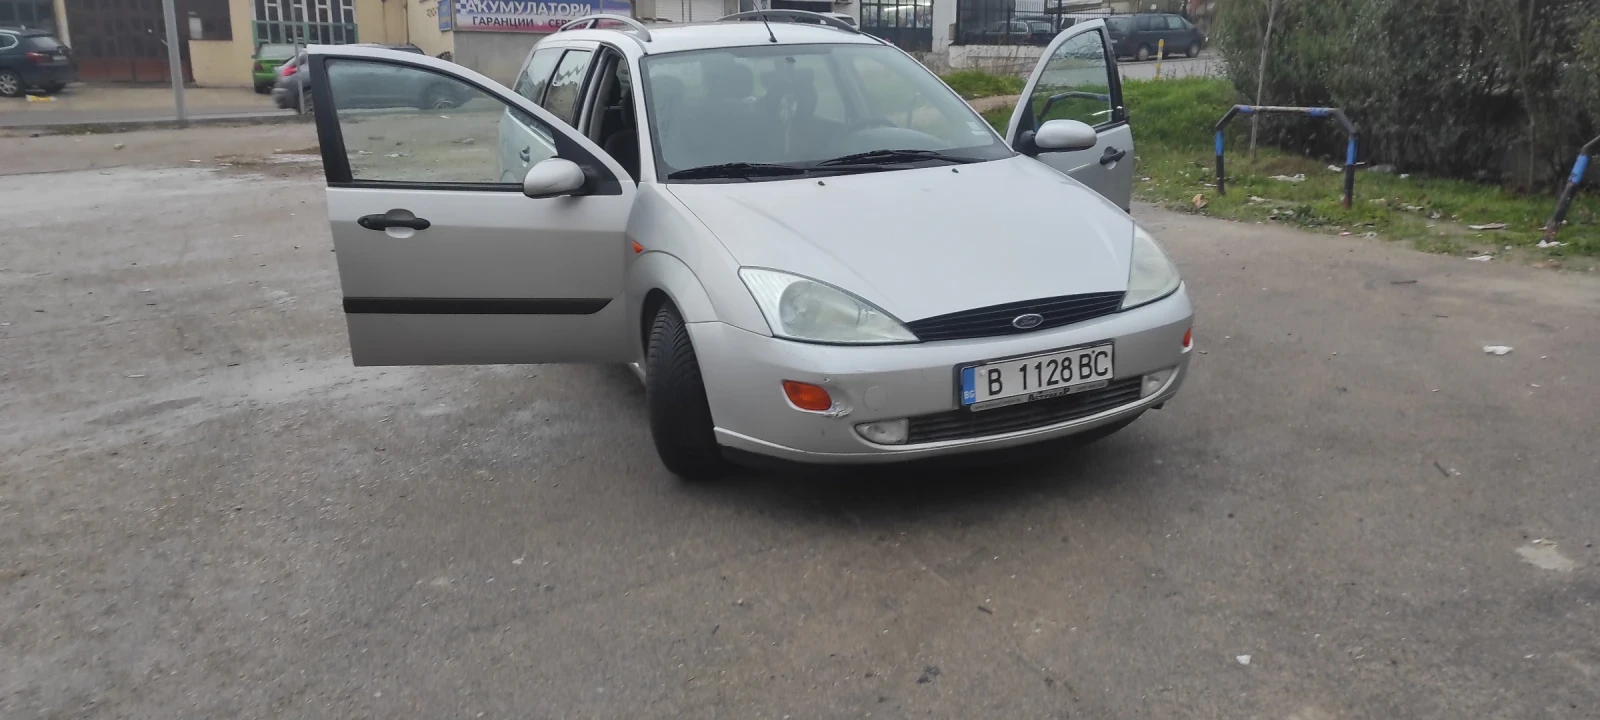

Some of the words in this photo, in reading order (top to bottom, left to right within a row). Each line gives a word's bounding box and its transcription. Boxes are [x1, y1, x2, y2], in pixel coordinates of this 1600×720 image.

[466, 0, 592, 16] АКУМУЛАТОРИ
[472, 16, 534, 28] ГАРАНЦИИ
[548, 18, 587, 29] СЕР
[988, 368, 1003, 396] B
[1019, 357, 1073, 390] 1128
[1079, 351, 1108, 380] BC
[963, 390, 975, 400] BG
